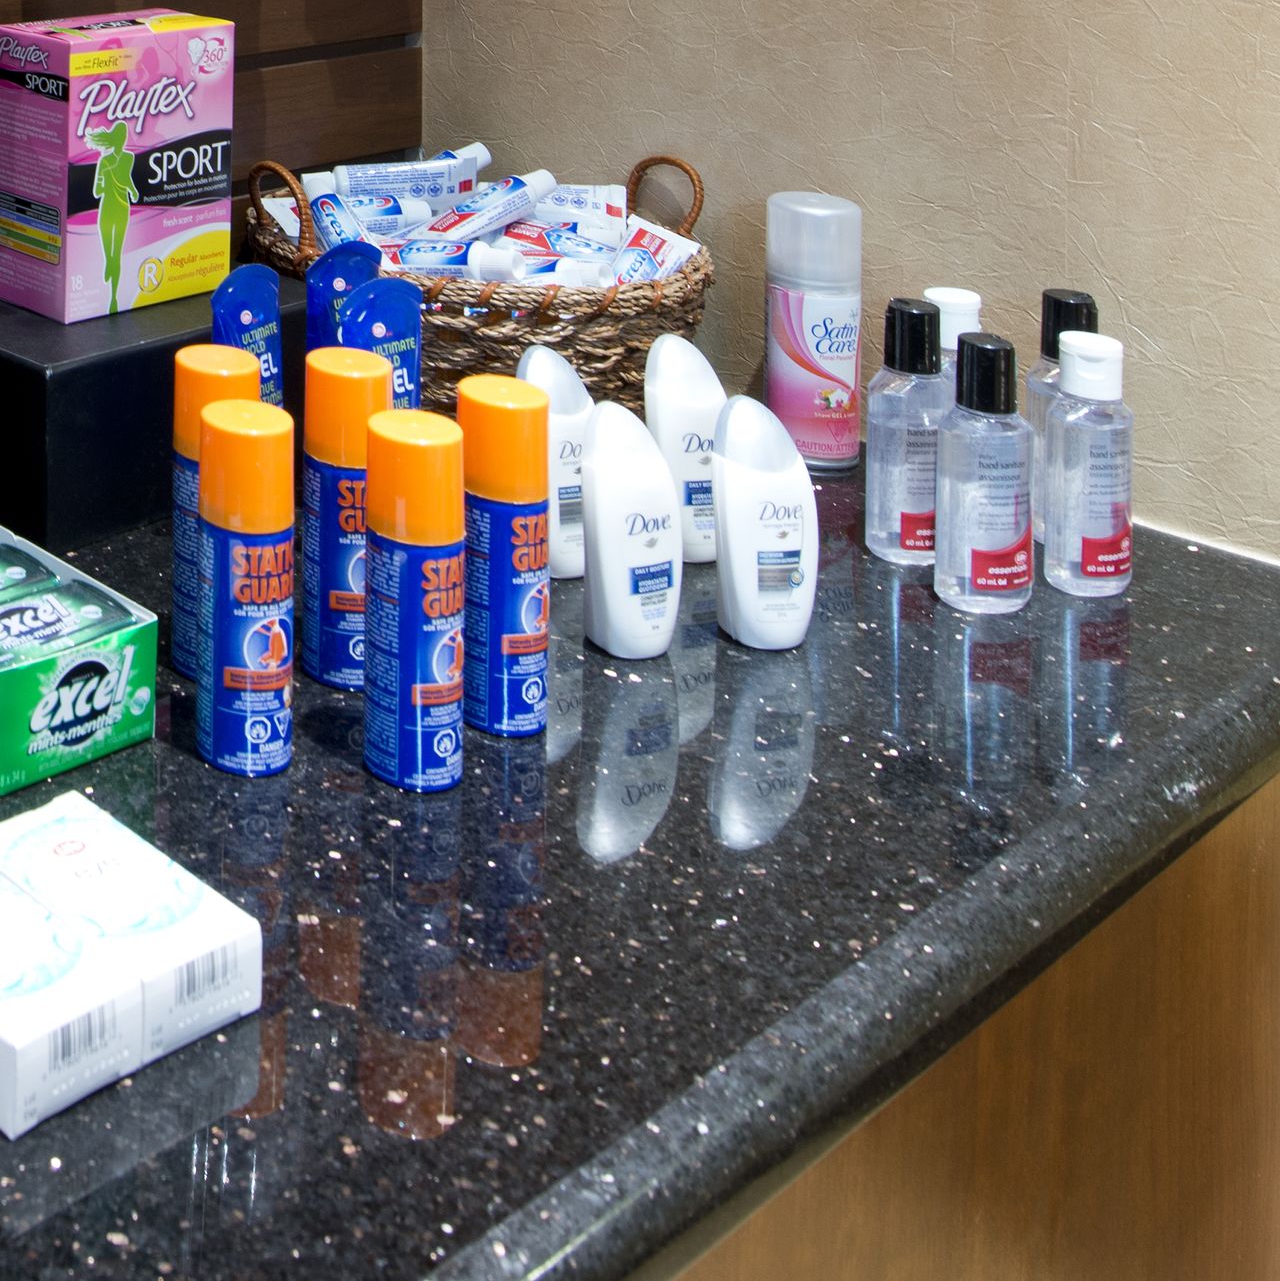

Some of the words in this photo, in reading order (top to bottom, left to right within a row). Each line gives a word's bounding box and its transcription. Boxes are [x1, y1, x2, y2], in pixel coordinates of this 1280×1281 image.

[91, 55, 120, 68] FlexFit
[25, 73, 68, 98] SPORT
[76, 77, 197, 137] Playtex
[147, 140, 228, 185] SPORT
[318, 197, 349, 245] Crest
[402, 242, 466, 257] Crest
[143, 262, 159, 288] R
[195, 261, 225, 278] régulière
[615, 250, 650, 286] Crest
[70, 274, 83, 288] 18
[241, 321, 278, 344] ULTIMATE
[811, 316, 858, 340] Satin
[372, 336, 417, 357] ULTIMATE
[815, 339, 856, 355] Care
[759, 501, 803, 522] Dove
[625, 512, 671, 537] Dove
[977, 578, 987, 586] 60
[29, 645, 136, 735] excel
